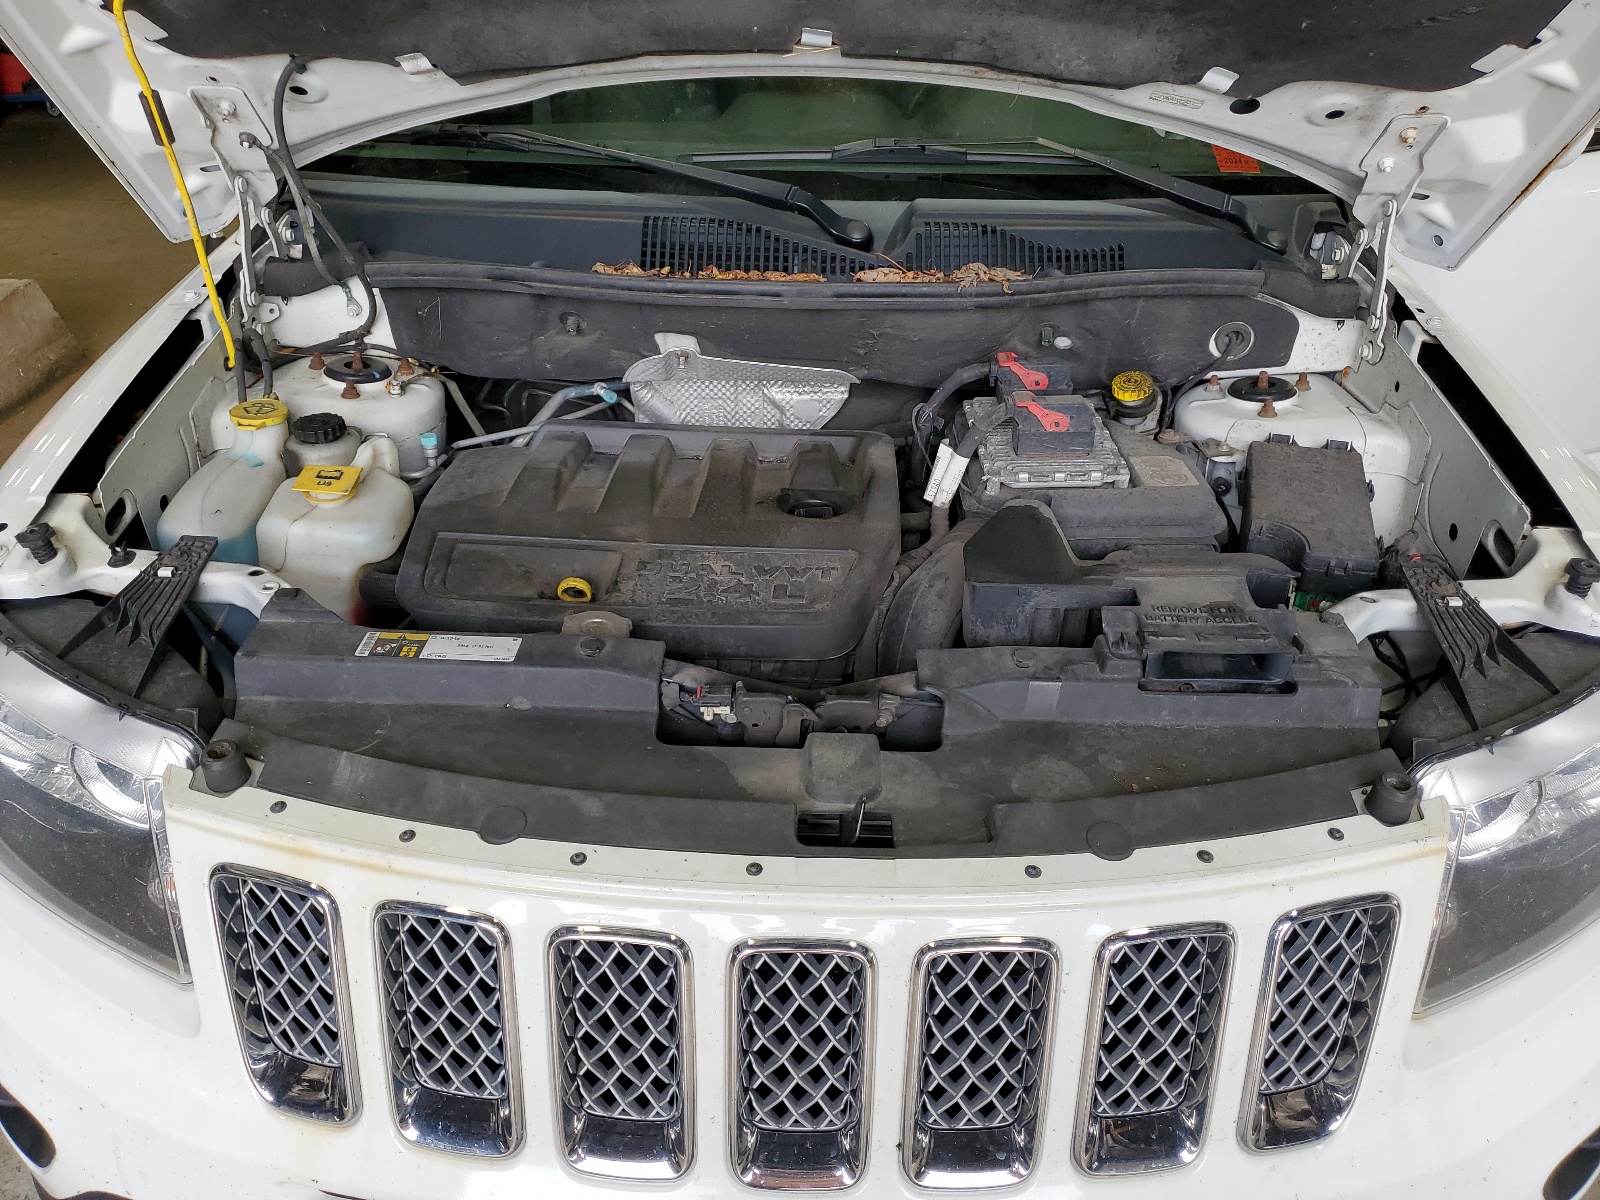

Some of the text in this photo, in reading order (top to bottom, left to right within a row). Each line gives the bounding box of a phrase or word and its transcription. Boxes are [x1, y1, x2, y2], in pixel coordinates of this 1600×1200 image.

[752, 563, 840, 582] VVT
[1150, 604, 1238, 614] REMOVE FOR
[1144, 614, 1200, 624] BATTERY
